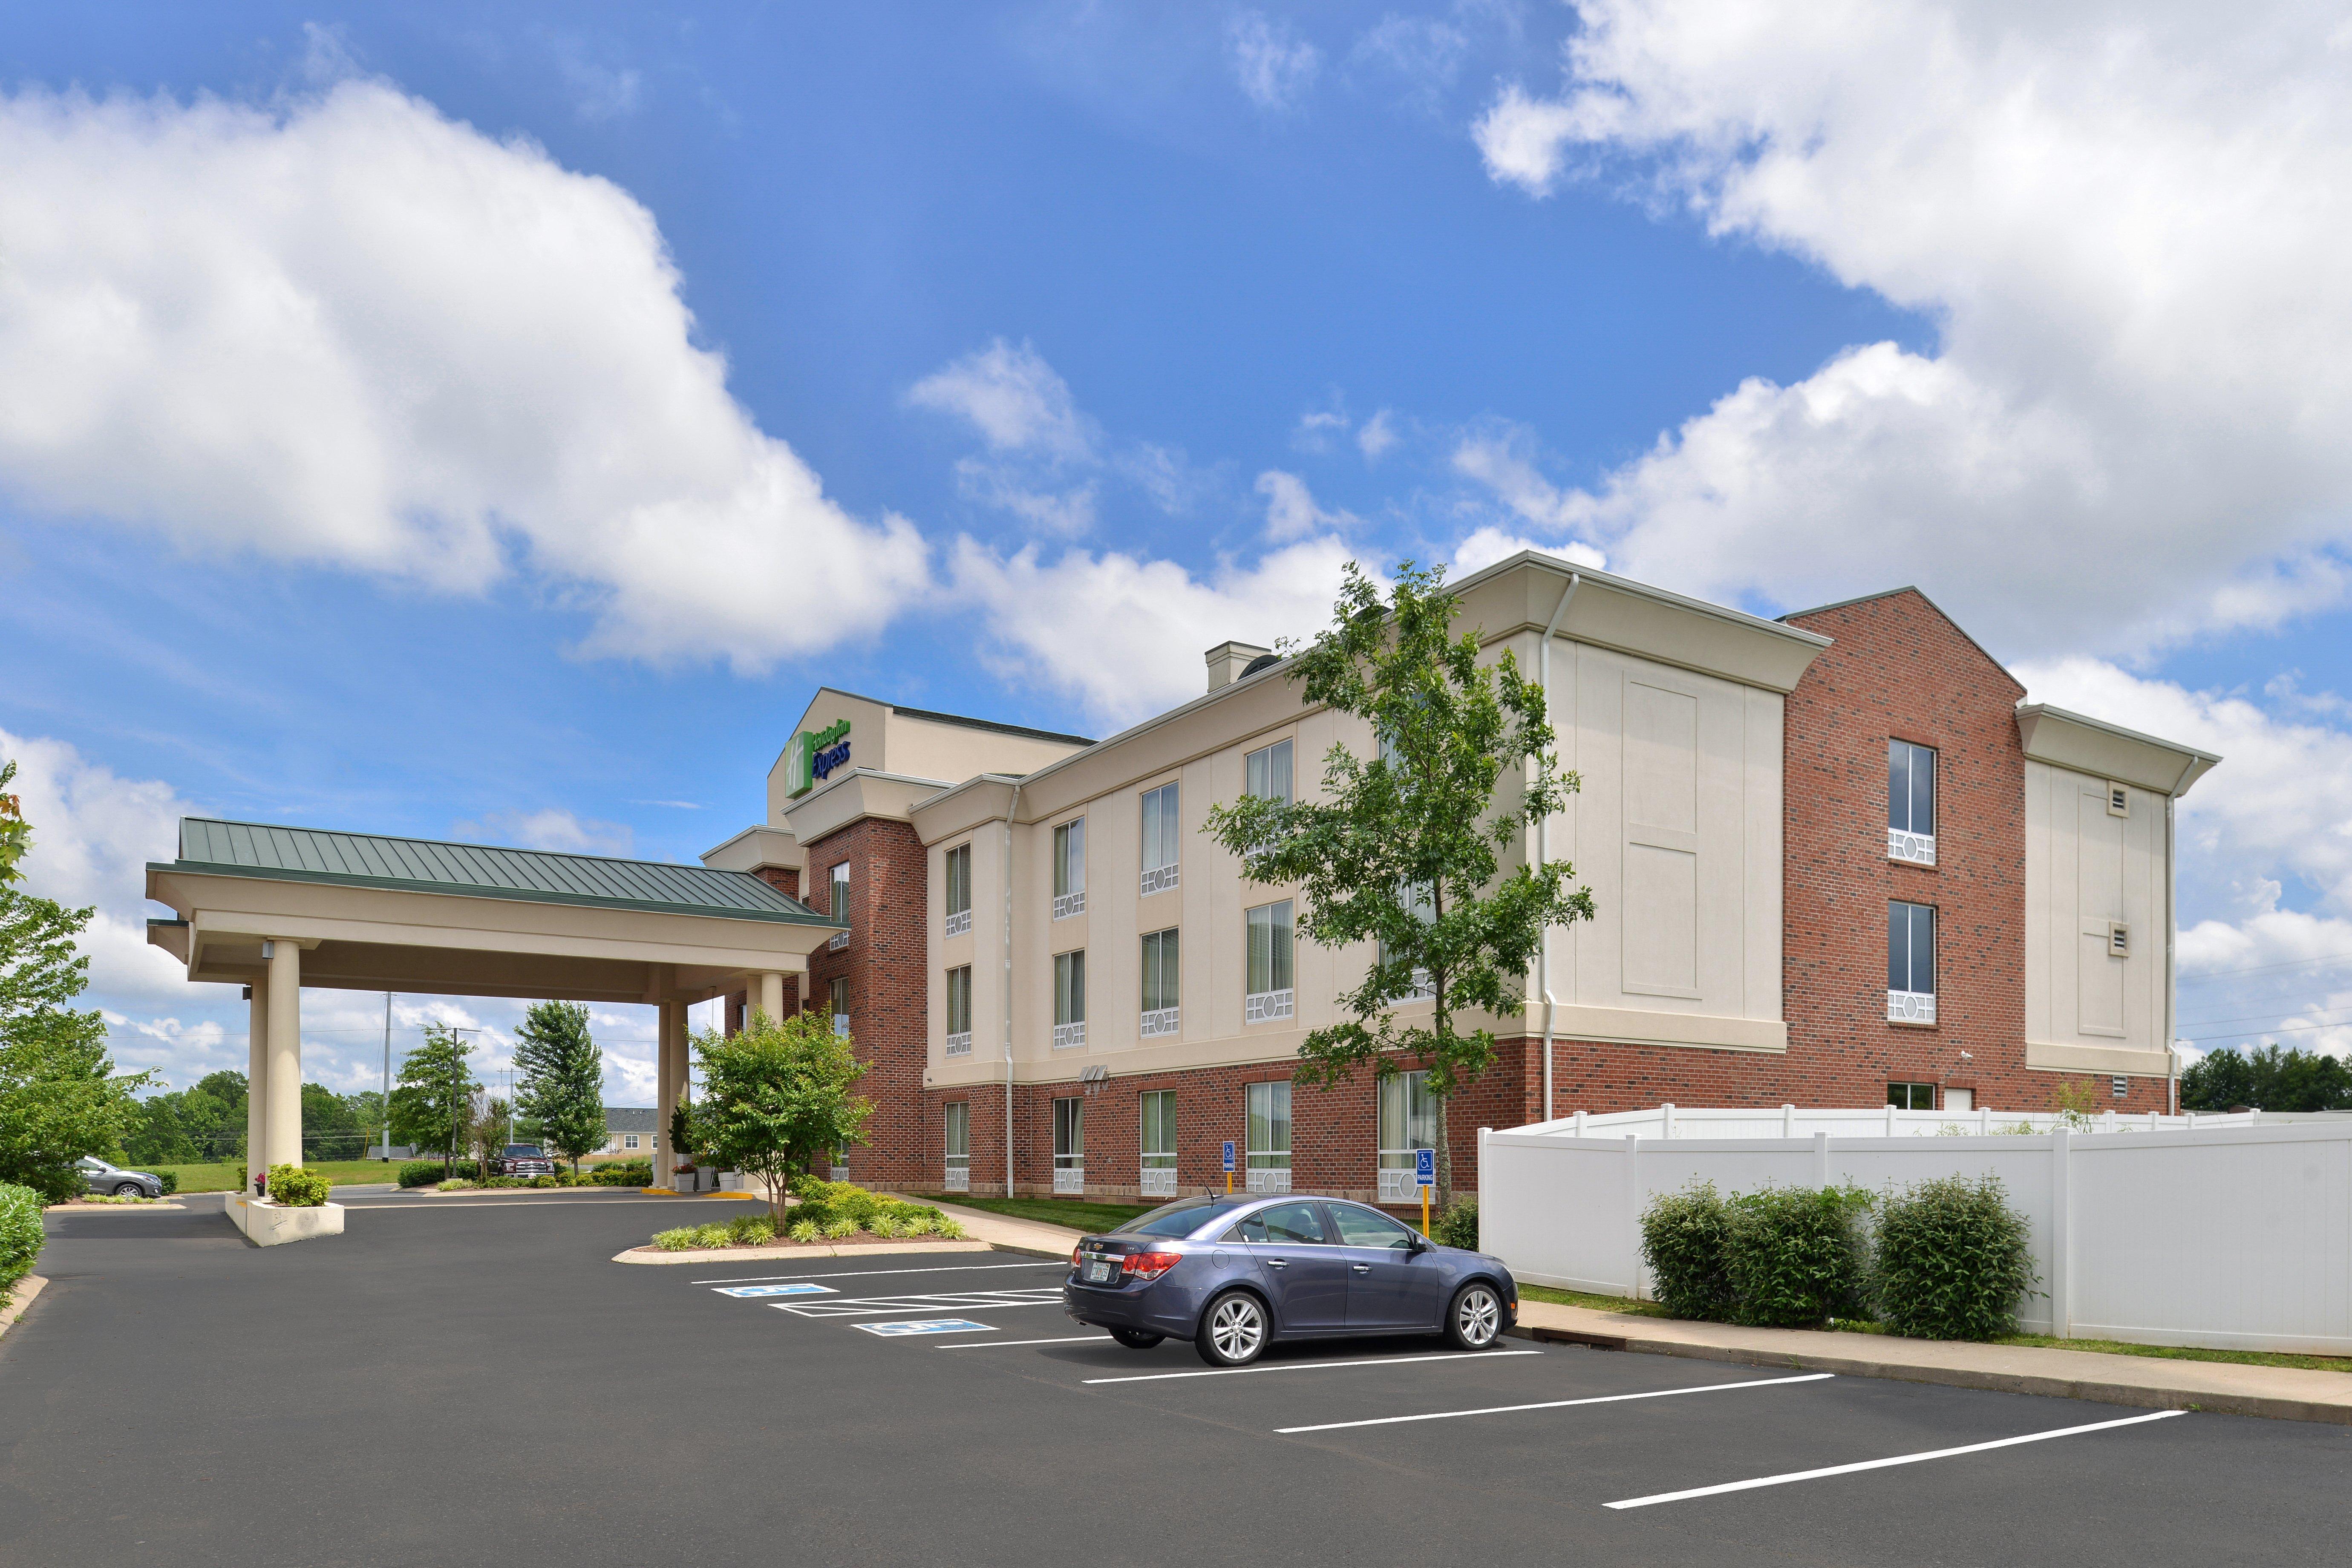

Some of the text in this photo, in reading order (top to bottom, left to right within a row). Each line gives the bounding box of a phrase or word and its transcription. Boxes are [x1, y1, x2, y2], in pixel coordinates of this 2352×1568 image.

[813, 719, 848, 750] Holiday Inn
[787, 738, 804, 789] H
[812, 741, 850, 779] Express
